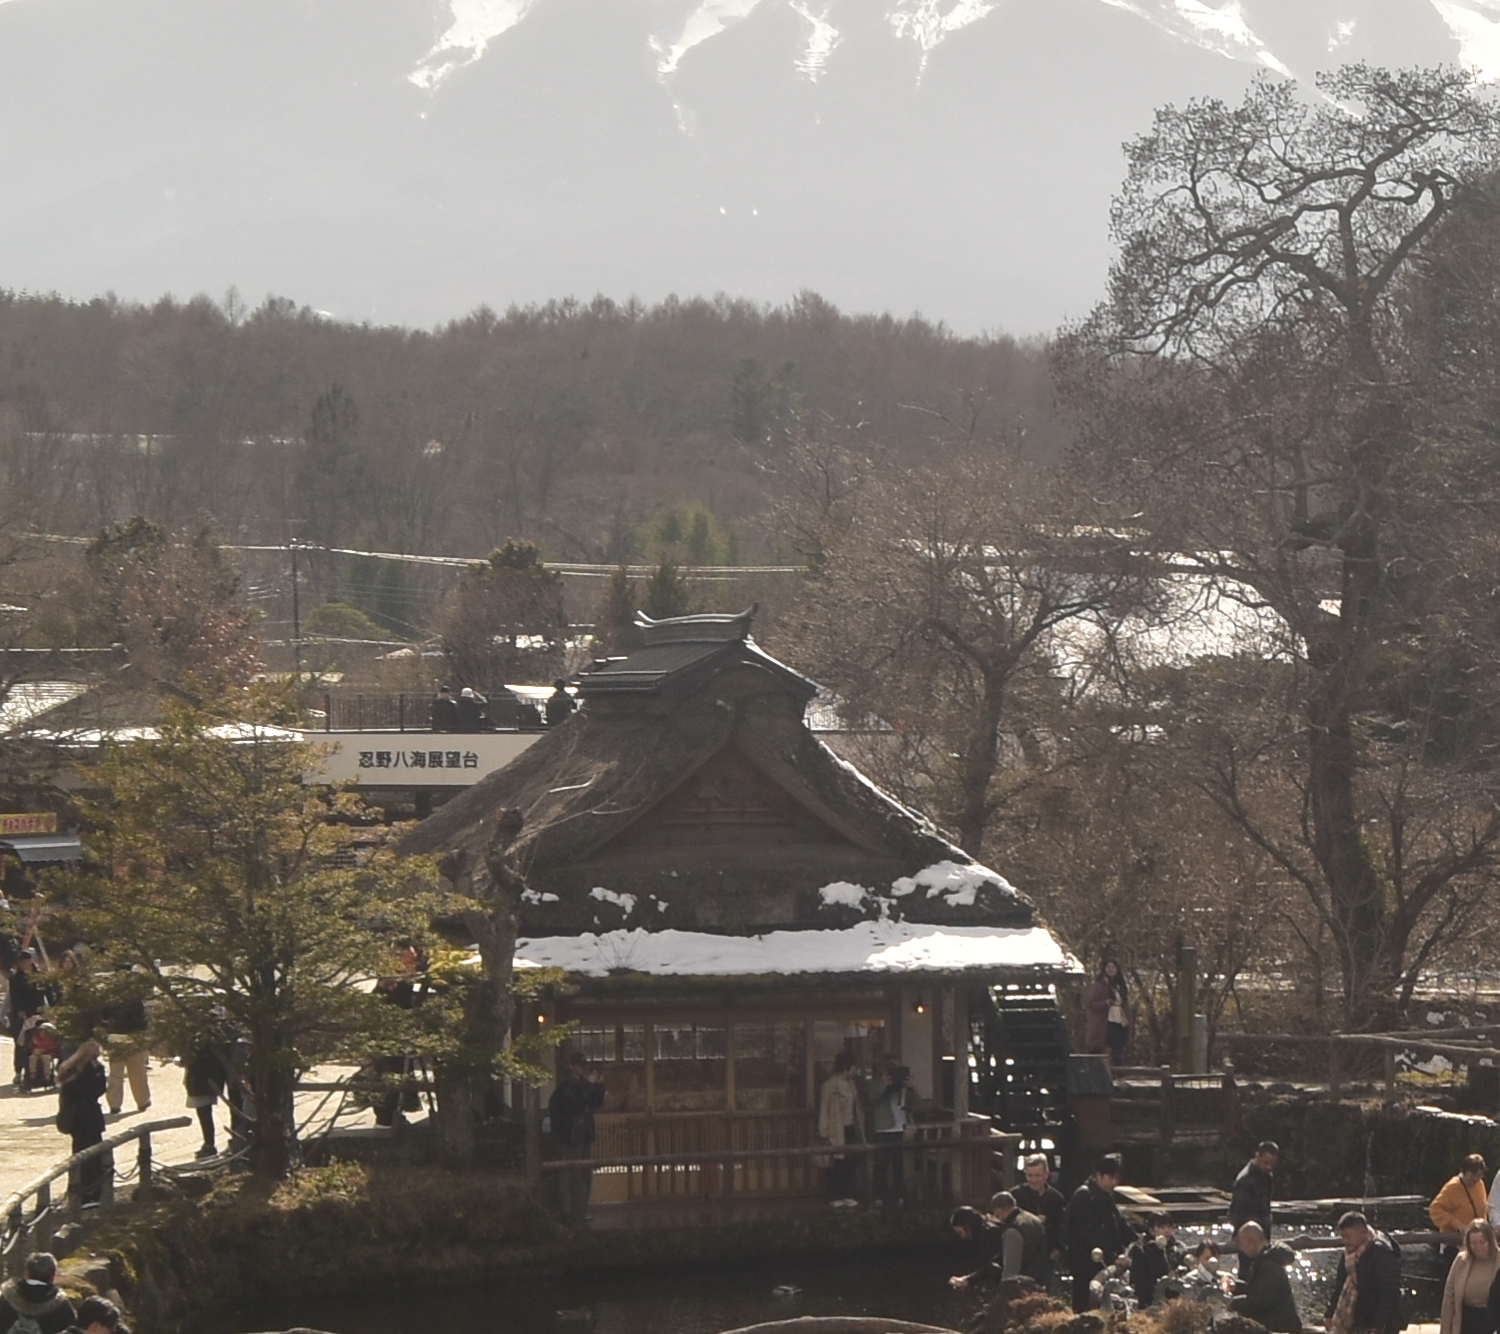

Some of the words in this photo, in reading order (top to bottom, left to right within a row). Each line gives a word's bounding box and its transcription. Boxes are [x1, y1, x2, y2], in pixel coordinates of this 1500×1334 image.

[358, 750, 479, 768] 忍野八海展望台
